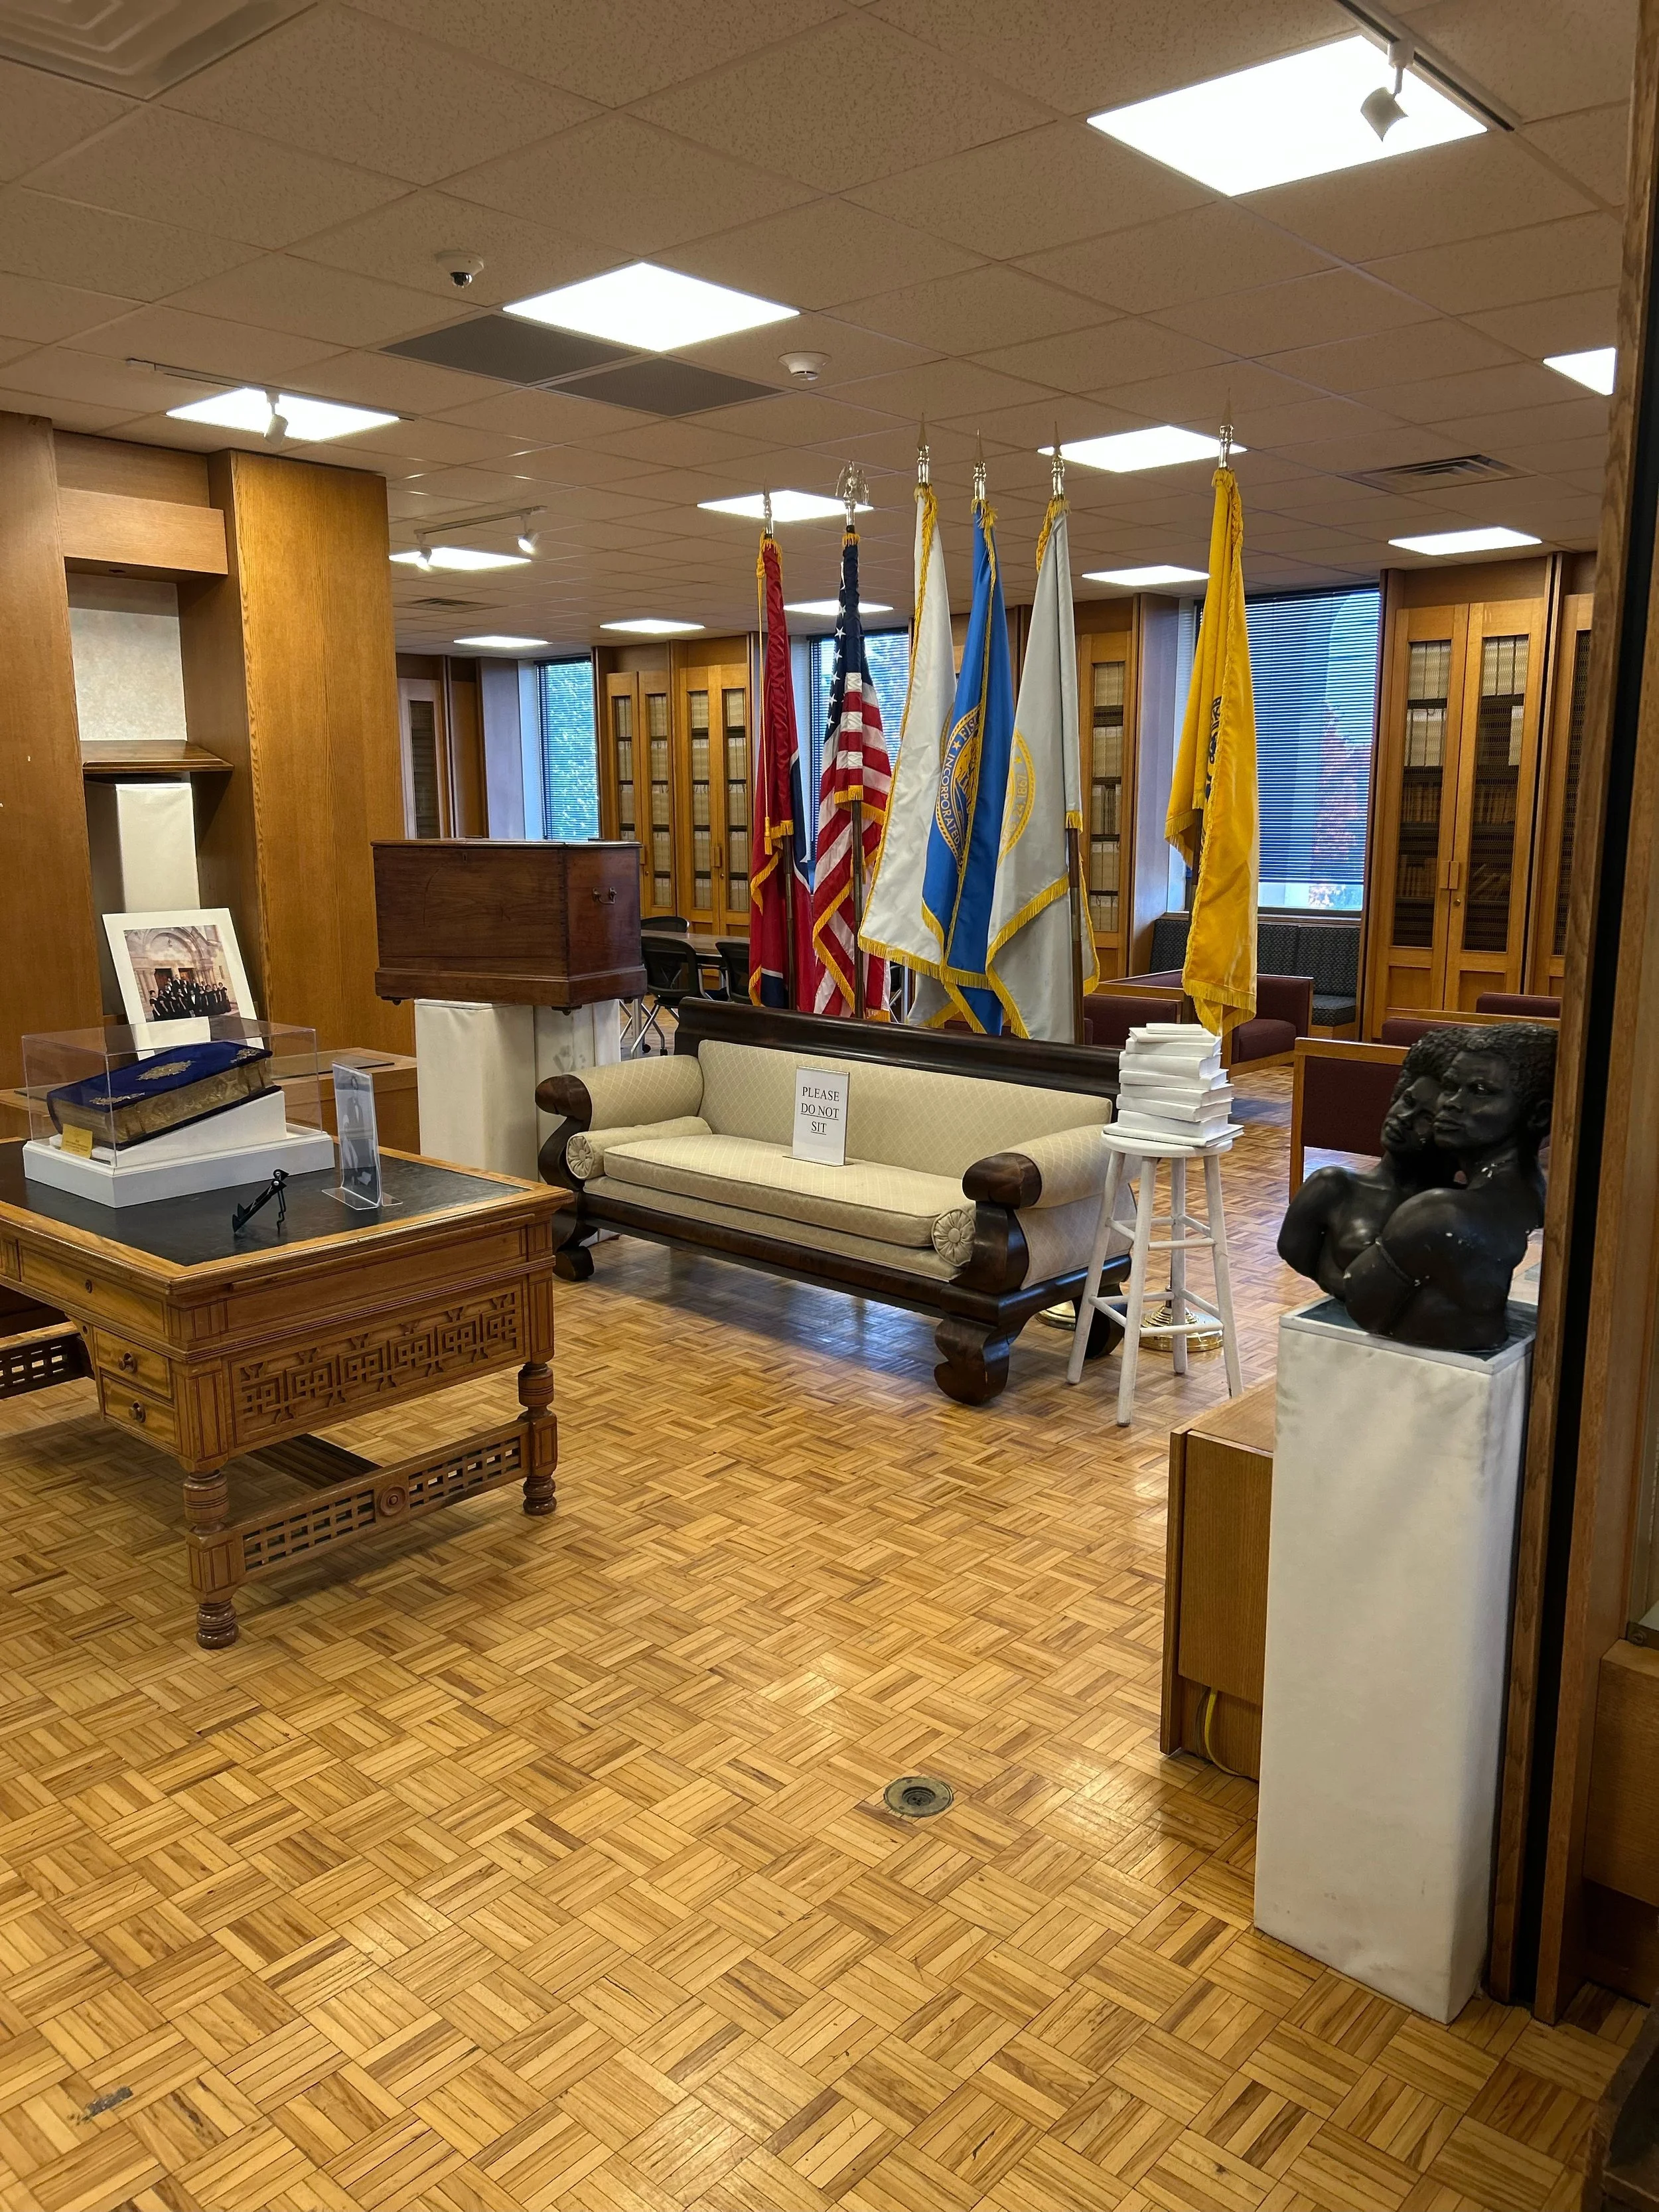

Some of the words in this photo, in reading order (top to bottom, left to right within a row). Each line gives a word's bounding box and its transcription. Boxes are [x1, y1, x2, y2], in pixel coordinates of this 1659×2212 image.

[958, 715, 976, 741] FIS
[1017, 774, 1028, 798] 1867
[940, 753, 960, 845] INCORPORATED
[802, 1086, 839, 1101] PLEASE
[801, 1102, 816, 1114] DO
[818, 1106, 839, 1118] NOT
[811, 1121, 827, 1133] SIT
